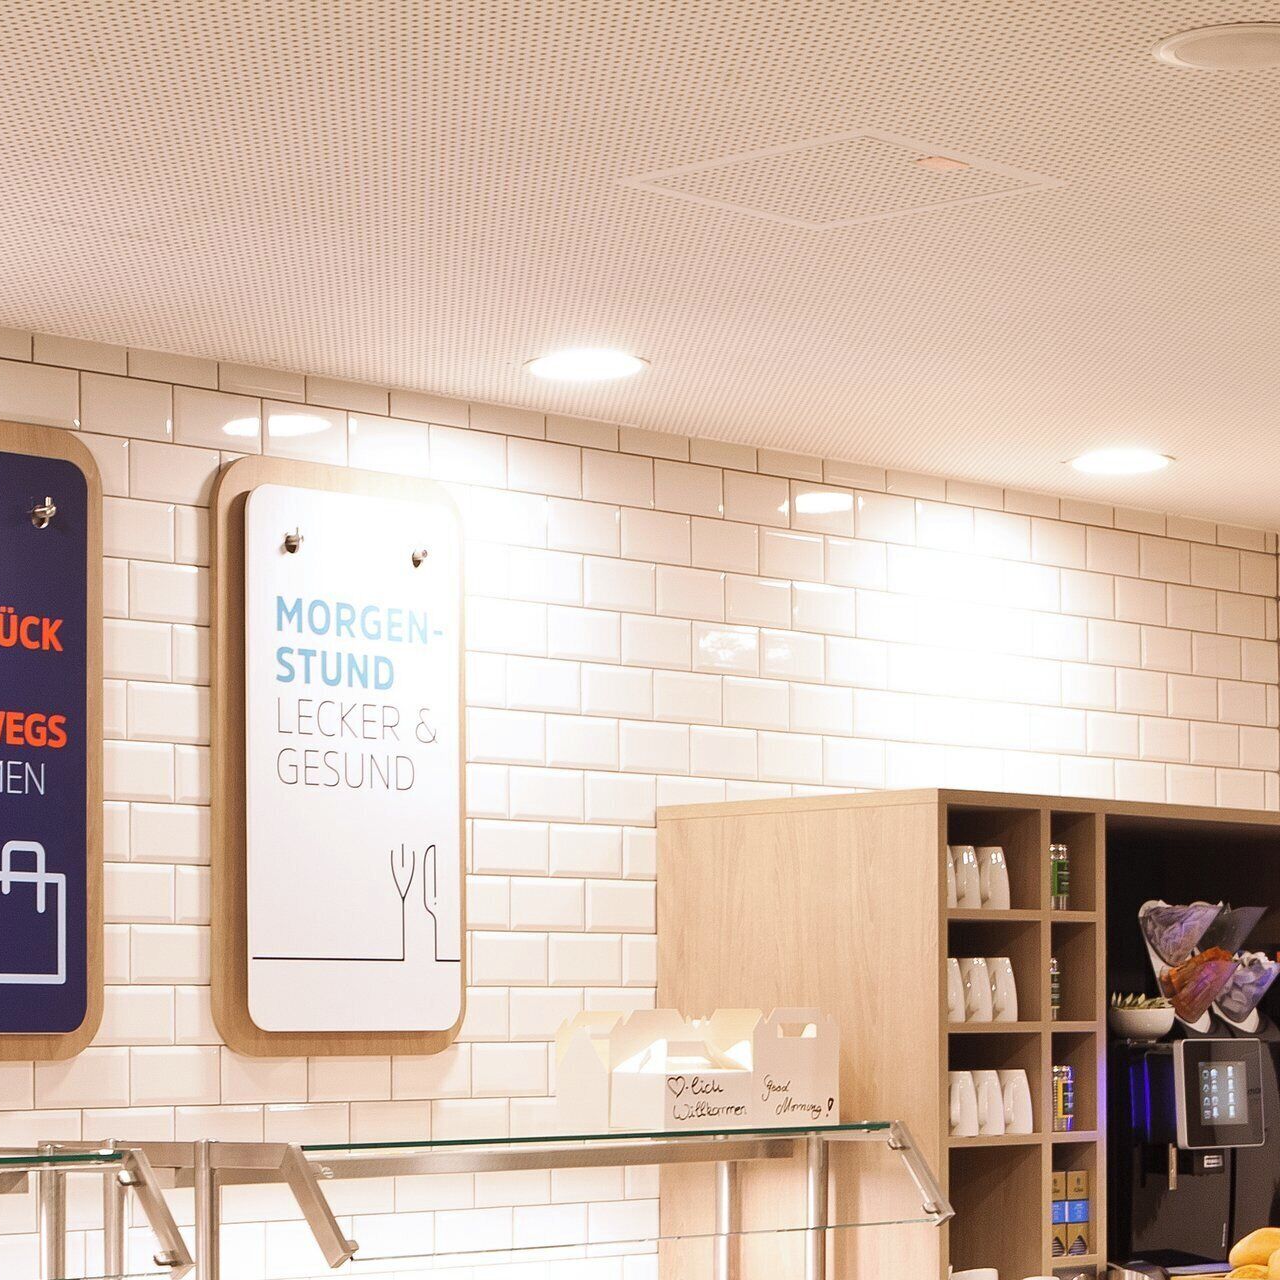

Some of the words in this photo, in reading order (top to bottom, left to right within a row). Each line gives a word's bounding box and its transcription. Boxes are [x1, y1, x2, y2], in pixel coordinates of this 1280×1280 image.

[276, 595, 444, 645] MORGEN-
[276, 646, 395, 691] STUND
[276, 696, 401, 743] LECKER
[414, 706, 438, 745] &
[276, 747, 416, 792] GESUND
